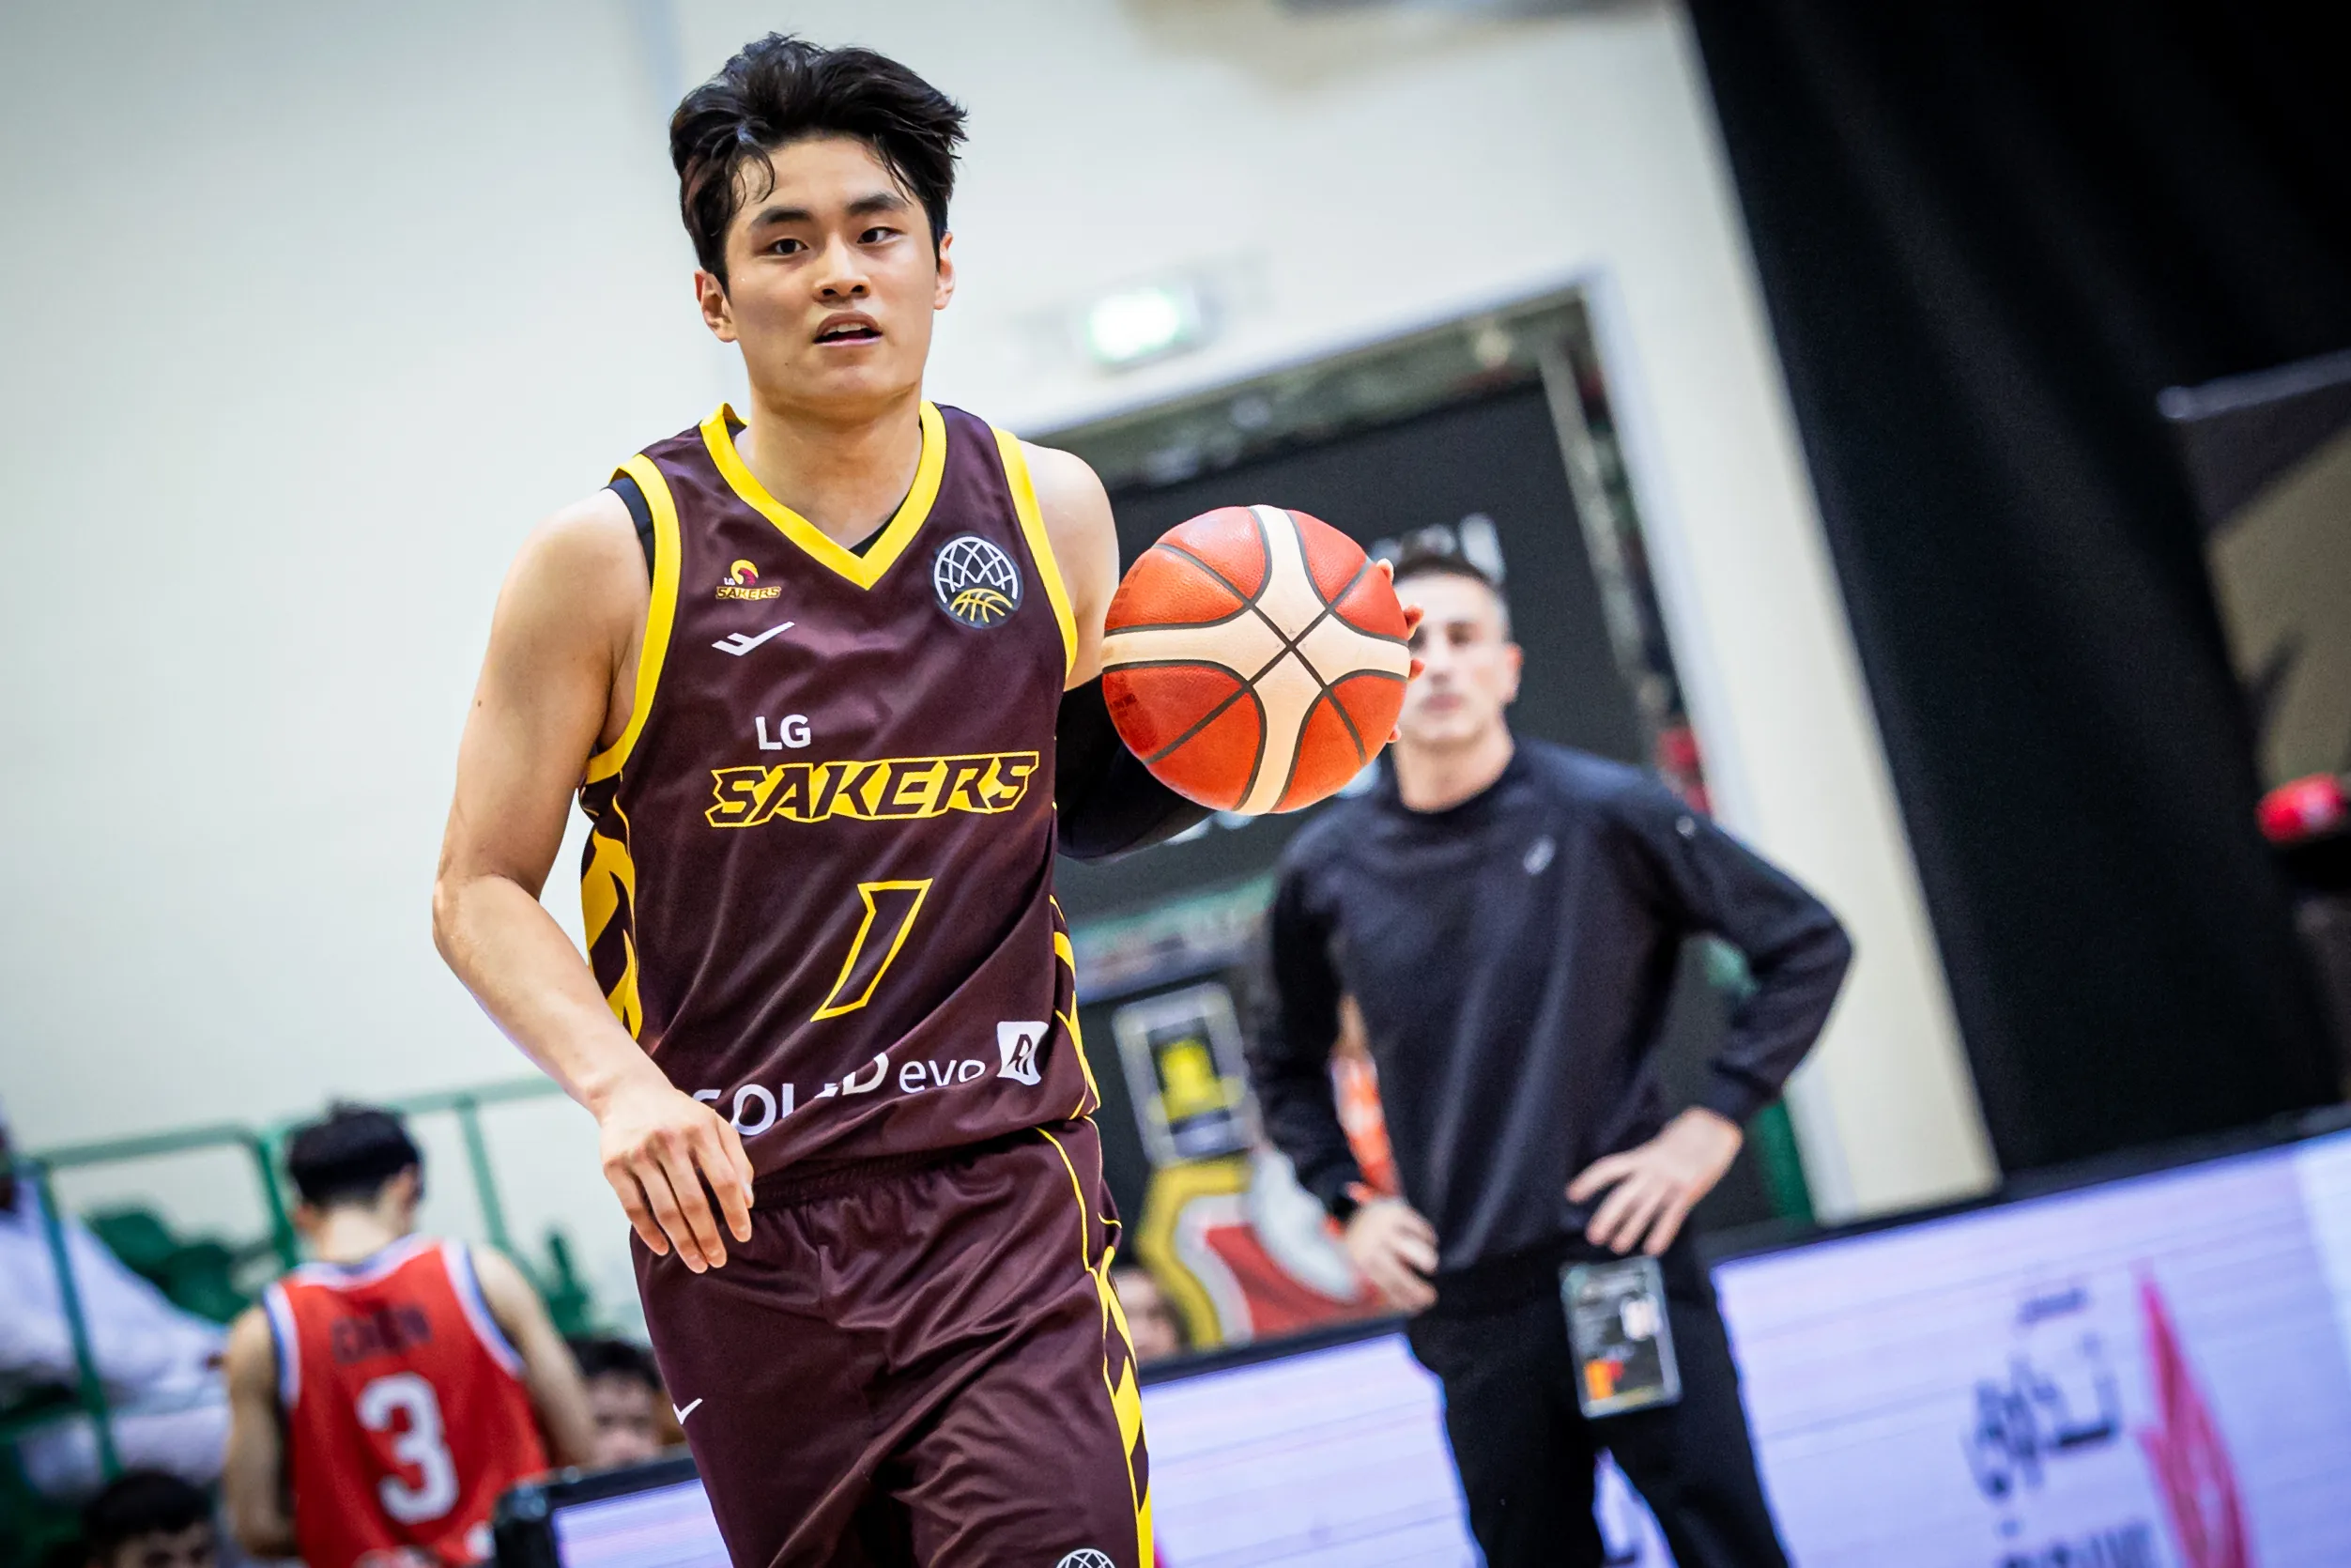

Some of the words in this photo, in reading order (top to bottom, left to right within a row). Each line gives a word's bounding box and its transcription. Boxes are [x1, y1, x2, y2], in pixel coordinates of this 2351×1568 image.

[715, 586, 781, 600] SAKERS
[756, 715, 810, 750] LG
[705, 751, 1039, 827] SAKERS
[899, 1059, 986, 1093] evo
[357, 1373, 459, 1525] 3
